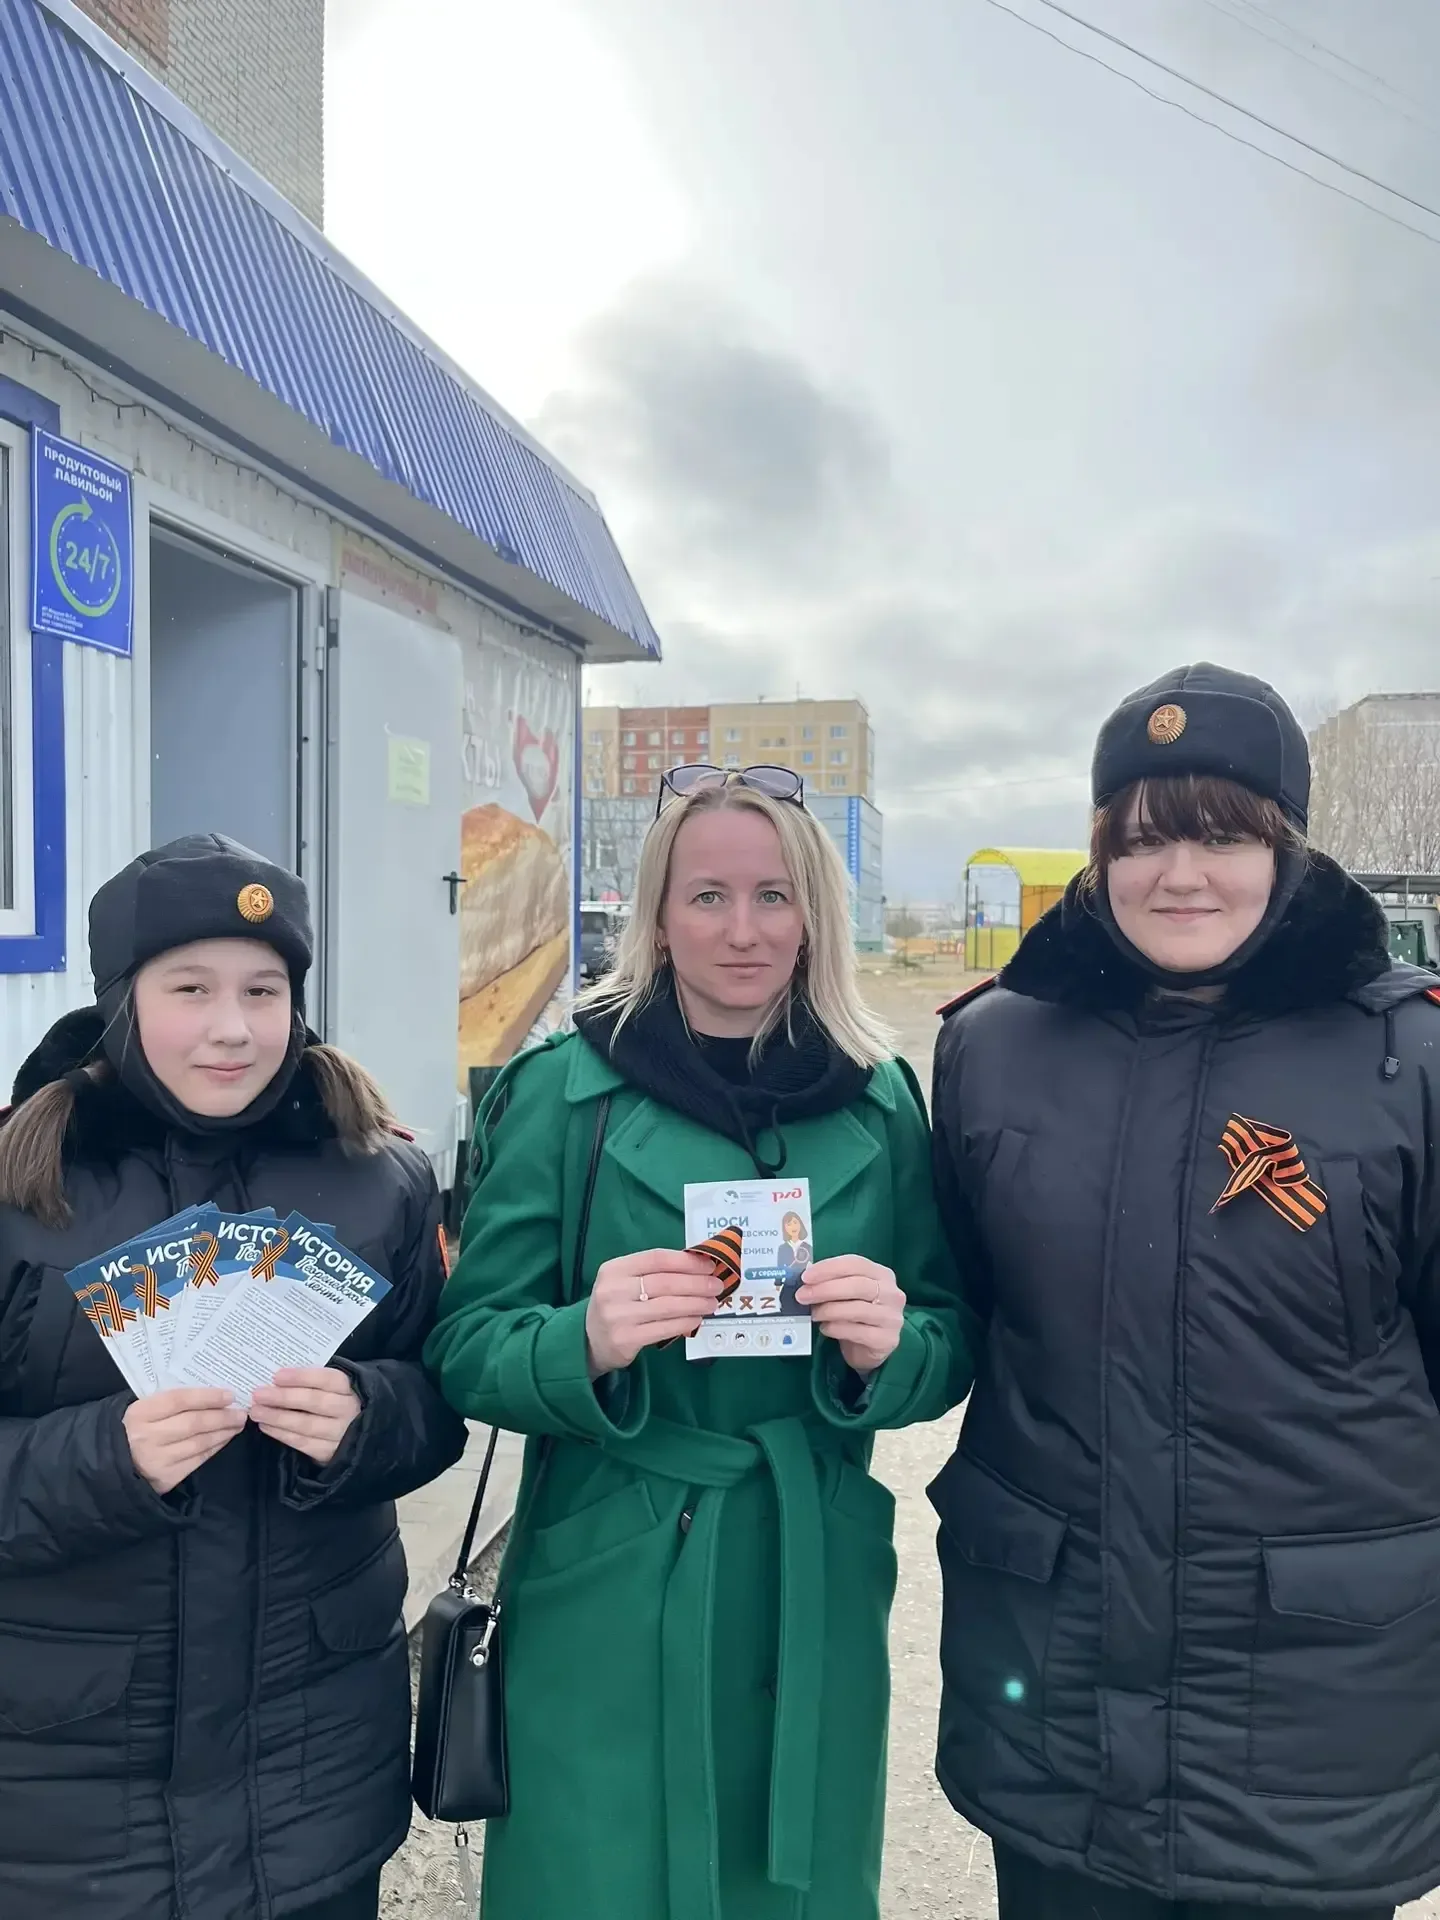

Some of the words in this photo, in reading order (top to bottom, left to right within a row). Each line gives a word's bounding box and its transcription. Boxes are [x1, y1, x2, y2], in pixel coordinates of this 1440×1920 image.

[44, 445, 122, 493] ПРОДУКТОВЫЙ
[54, 466, 113, 503] ПАВИЛЬОН
[65, 540, 111, 583] 24/7
[706, 1216, 749, 1229] НОСИ
[291, 1225, 376, 1294] ИСТОРИЯ
[741, 1247, 774, 1256] ЕНИЕМ
